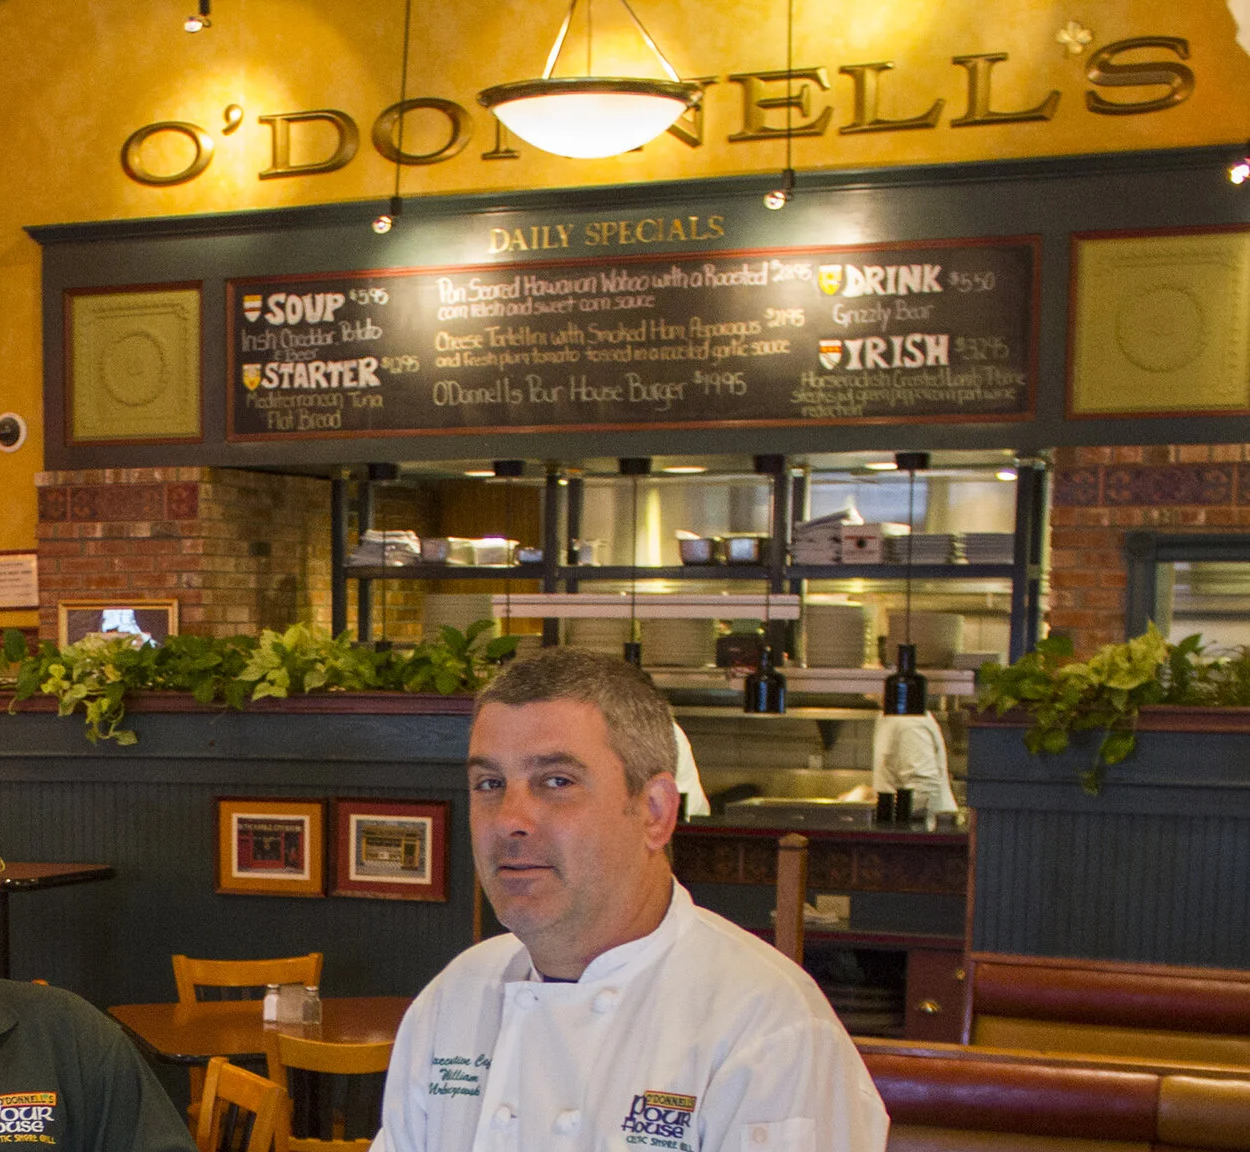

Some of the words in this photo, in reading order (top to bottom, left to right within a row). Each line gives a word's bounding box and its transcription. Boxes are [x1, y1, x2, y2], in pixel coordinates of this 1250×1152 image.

[119, 34, 1197, 188] O'DOELL'S
[488, 224, 573, 254] DAILY
[585, 215, 725, 249] SPECIALS
[842, 264, 944, 298] DRINK
[264, 292, 345, 325] SOUP
[832, 302, 891, 331] Grizzly
[844, 332, 950, 370] IRISH
[261, 356, 381, 389] STARTER
[525, 373, 564, 403] Pour
[570, 374, 623, 402] House
[624, 372, 687, 412] Burger
